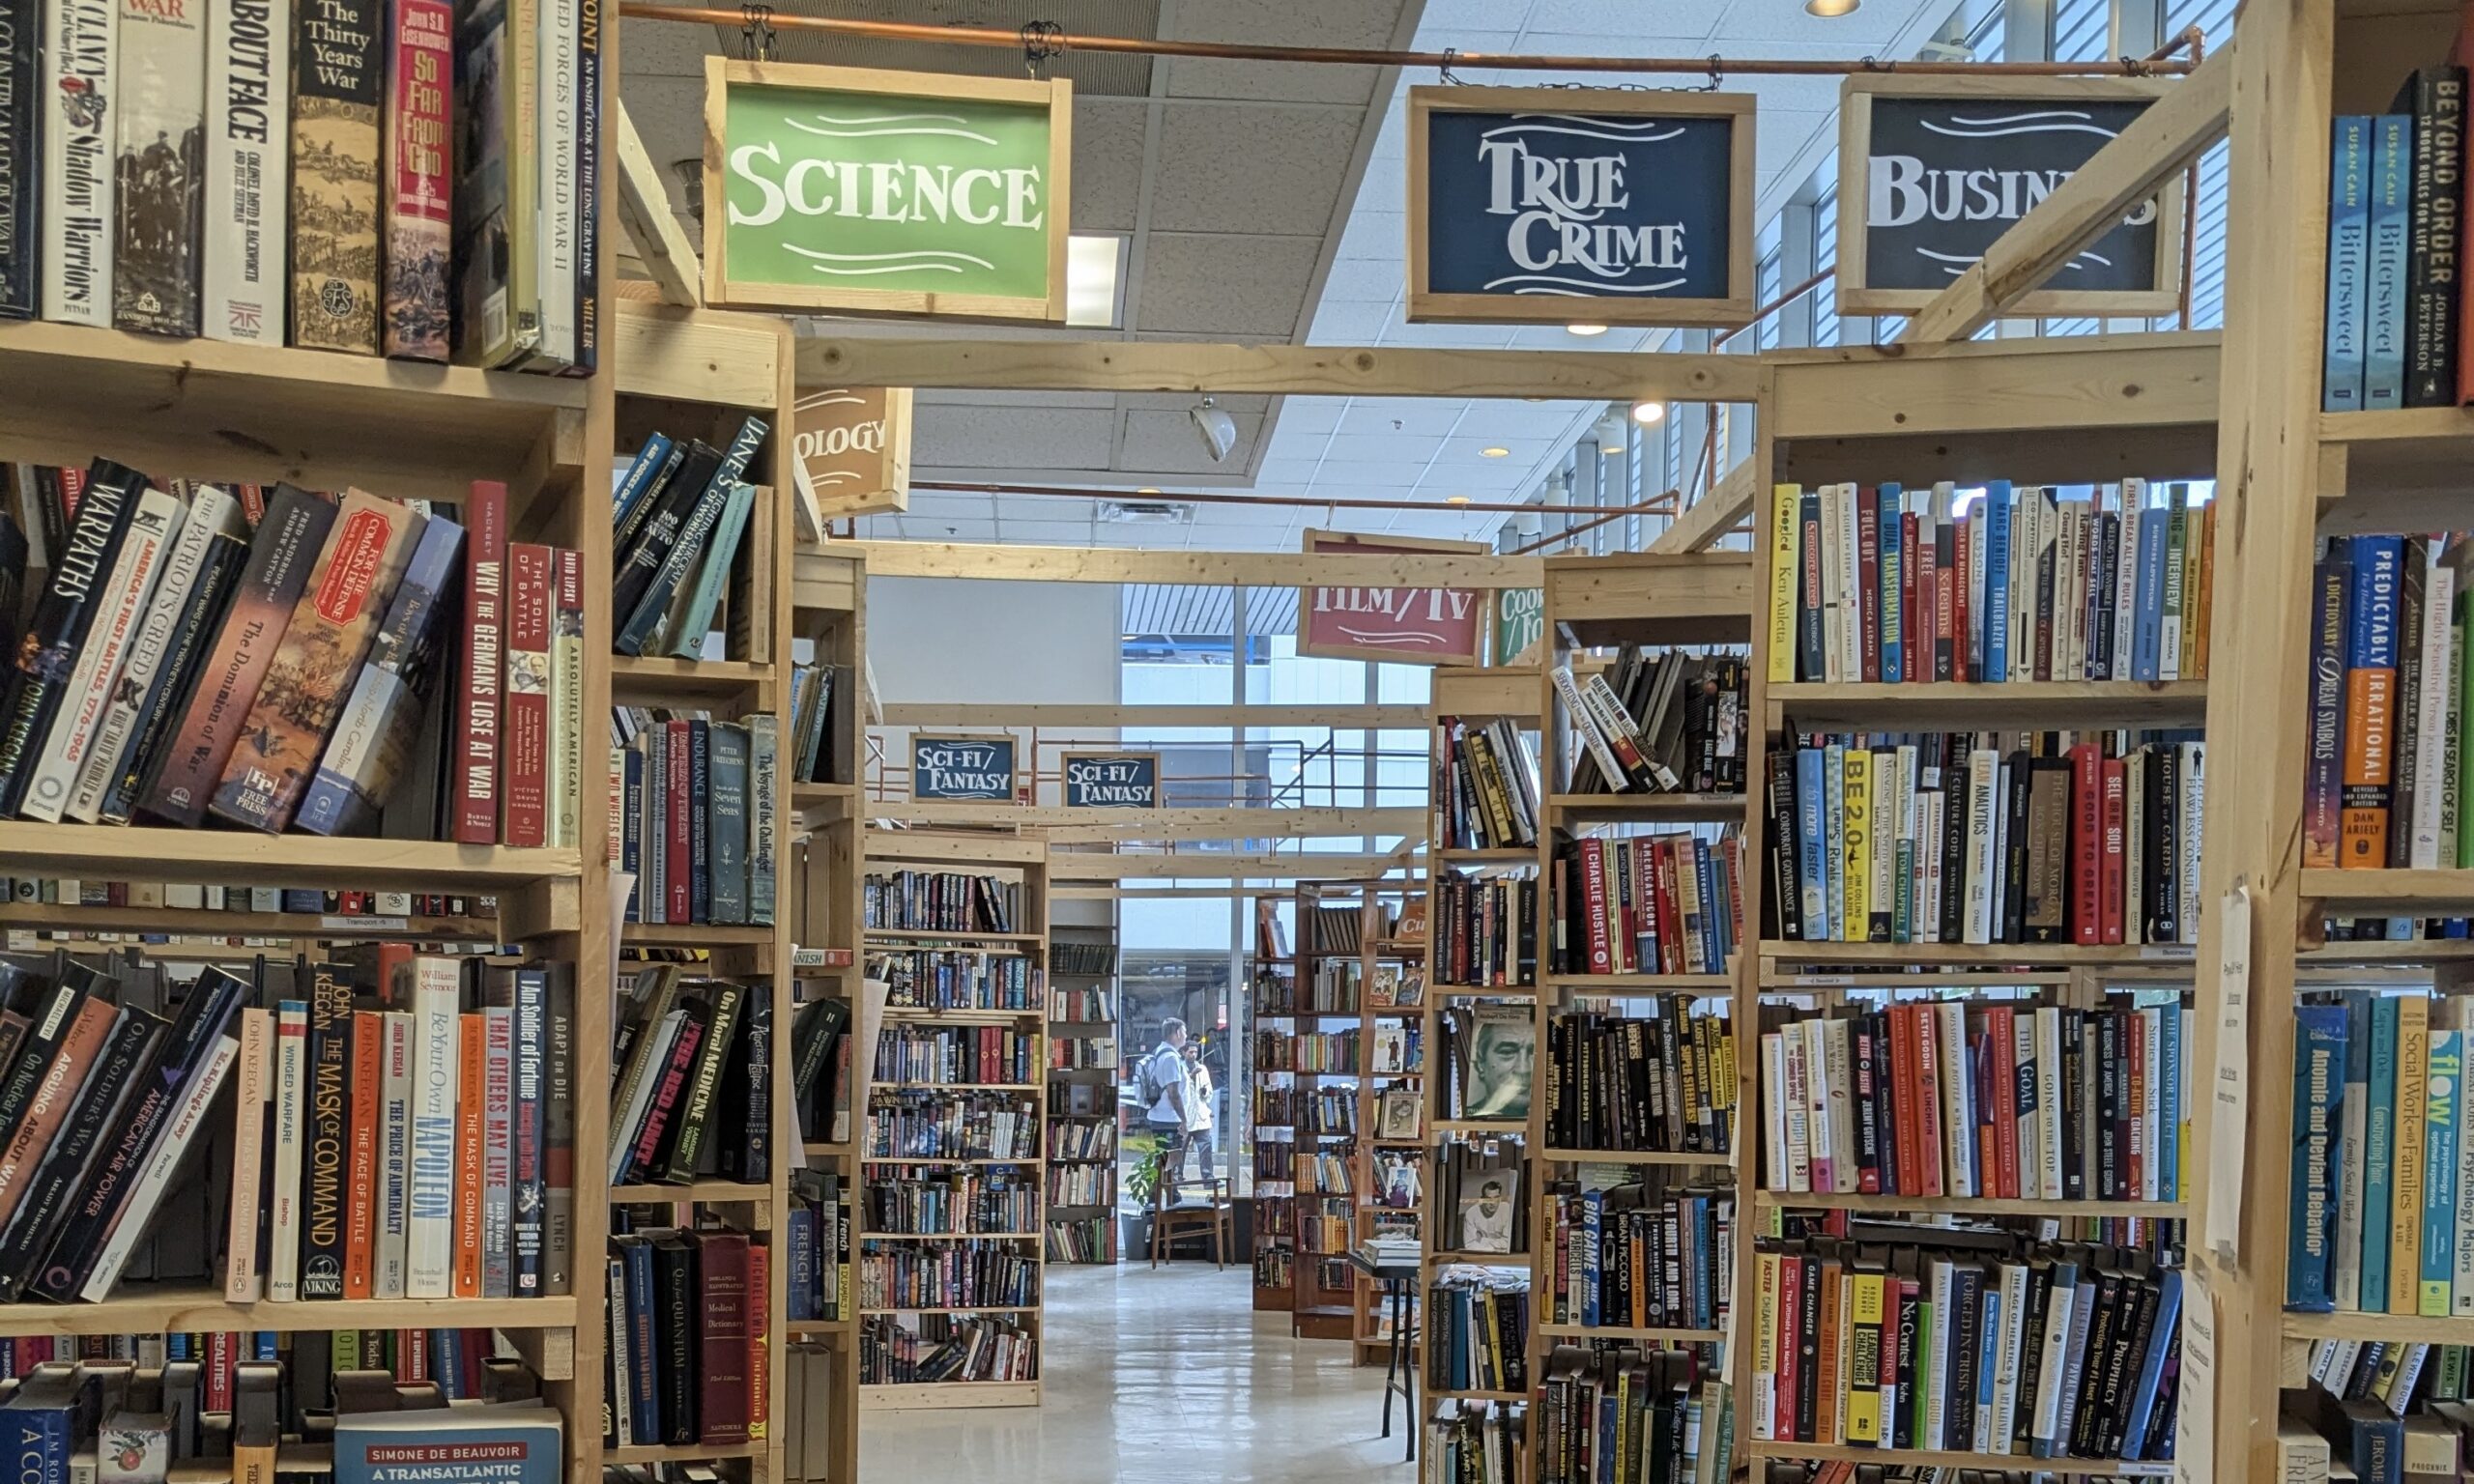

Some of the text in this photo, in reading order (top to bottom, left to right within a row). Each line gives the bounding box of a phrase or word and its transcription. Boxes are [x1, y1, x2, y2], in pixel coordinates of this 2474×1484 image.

[129, 0, 186, 19] WAR
[305, 19, 370, 51] Thirty
[317, 0, 359, 23] The
[312, 43, 362, 69] Years
[317, 65, 359, 90] War
[227, 74, 269, 144] FACE
[555, 35, 569, 248] FORCES OF WORLD WAR
[729, 141, 1042, 231] SCIENCE
[1479, 137, 1628, 220] TRUE
[2430, 81, 2460, 284] BEYOND ORDER
[64, 131, 104, 302] Shadow Warriors
[1508, 211, 1687, 277] CRIME
[2336, 224, 2361, 354] Bittersweet
[2375, 224, 2401, 354] Bittersweet
[583, 297, 594, 349] MILLER
[2417, 295, 2431, 371] PETERSON
[2432, 294, 2445, 353] JORDAN
[717, 419, 768, 490] JANE'S
[54, 482, 126, 603] WARPATHS
[1777, 498, 1794, 643] Googled Ken Auletta
[134, 520, 208, 677] PATRIOT'S CREED
[1884, 552, 1899, 643] TRANSFORMATION
[2167, 549, 2182, 607] INTERVIEW
[517, 583, 529, 640] BATTLE
[532, 595, 542, 637] SOUL
[1993, 587, 2004, 649] TRAILBLAZER
[2324, 585, 2341, 647] DICTIONARY
[68, 539, 157, 763] AMERICA'S FIRST 1776-1965
[213, 620, 264, 724] The Dominion
[468, 561, 500, 800] WHY THE GERMANS LOSE AT WAR
[2365, 551, 2393, 780] PREDICTABLY IRRATIONAL
[567, 644, 578, 797] ABSOLUTELY AMERICAN
[2316, 710, 2335, 759] SYMBOLS
[694, 730, 705, 797] ENDURANCE
[929, 768, 1010, 791] FANTASY
[1079, 782, 1153, 803] FANTASY
[236, 796, 266, 815] PRESS
[244, 788, 267, 806] FREE
[715, 792, 741, 804] Seven
[716, 805, 739, 816] Seas
[1846, 760, 1864, 846] BE 2.0
[1973, 785, 1990, 835] ANALYTICS
[2108, 776, 2122, 853] SELL SOLD
[2162, 755, 2172, 875] HOUSE CARDS
[2352, 811, 2374, 823] DAN
[2083, 792, 2095, 919] GOOD GREAT
[2345, 823, 2380, 836] ARIELY
[1588, 853, 1605, 948] CHARLIE HUSTLE
[1643, 843, 1655, 900] AMERICAN
[1896, 876, 1909, 925] CHAPPELL
[50, 989, 72, 1020] MICHAEL
[314, 972, 334, 1031] KEEGAN
[332, 985, 352, 1020] JOHN
[420, 969, 457, 983] William
[521, 1000, 540, 1042] Soldier
[1920, 1013, 1931, 1070] SETH GODIN
[281, 1044, 296, 1145] WINGED WARFARE
[520, 1058, 540, 1099] Fortune
[690, 1013, 730, 1123] Moral MEDICINE
[2020, 1066, 2033, 1108] GOAL
[2044, 1074, 2054, 1117] GOING
[2429, 1052, 2460, 1126] flow
[12, 1051, 73, 1163] ARGUING ABOUT
[486, 1057, 509, 1188] OTHERS LIVE
[553, 1016, 565, 1252] ADAPT LYNCH
[2130, 1117, 2142, 1155] COACHING
[2401, 1033, 2423, 1210] Social Work Families
[84, 1087, 159, 1217] AMERICAN POWER
[311, 1063, 342, 1246] MASK COMMAND
[412, 1115, 452, 1220] NAPOLEON
[2306, 1049, 2330, 1256] Anomie Deviant Behavior
[354, 1127, 369, 1243] THE FACE BATTLE
[387, 1173, 402, 1236] ADMIRALTY
[464, 1191, 475, 1247] COMMAND
[839, 1217, 849, 1251] French
[1583, 1201, 1598, 1272] BIG GAME
[797, 1224, 809, 1284] FRENCH
[1569, 1235, 1581, 1274] PARCELLS
[1619, 1214, 1628, 1292] BRIAN PICCOLO
[1664, 1217, 1680, 1311] FOURTH LONG
[303, 1278, 341, 1295] VIKING
[708, 1304, 735, 1313] Medical
[1760, 1261, 1772, 1370] FASTER CHEAPER BETTER
[1805, 1266, 1816, 1335] GAME CHANGER
[708, 1320, 743, 1328] Dictionary
[1899, 1301, 1915, 1403] No Contest Kohn
[1856, 1331, 1866, 1383] CHALLENGE
[1866, 1332, 1878, 1383] LEADERSHIP
[2105, 1341, 2129, 1406] PROPHECY
[372, 1446, 520, 1460] SIMONE DE BEAUVOIR
[373, 1465, 522, 1480] A TRANSATLANTIC
[2371, 1436, 2385, 1483] JEROME
